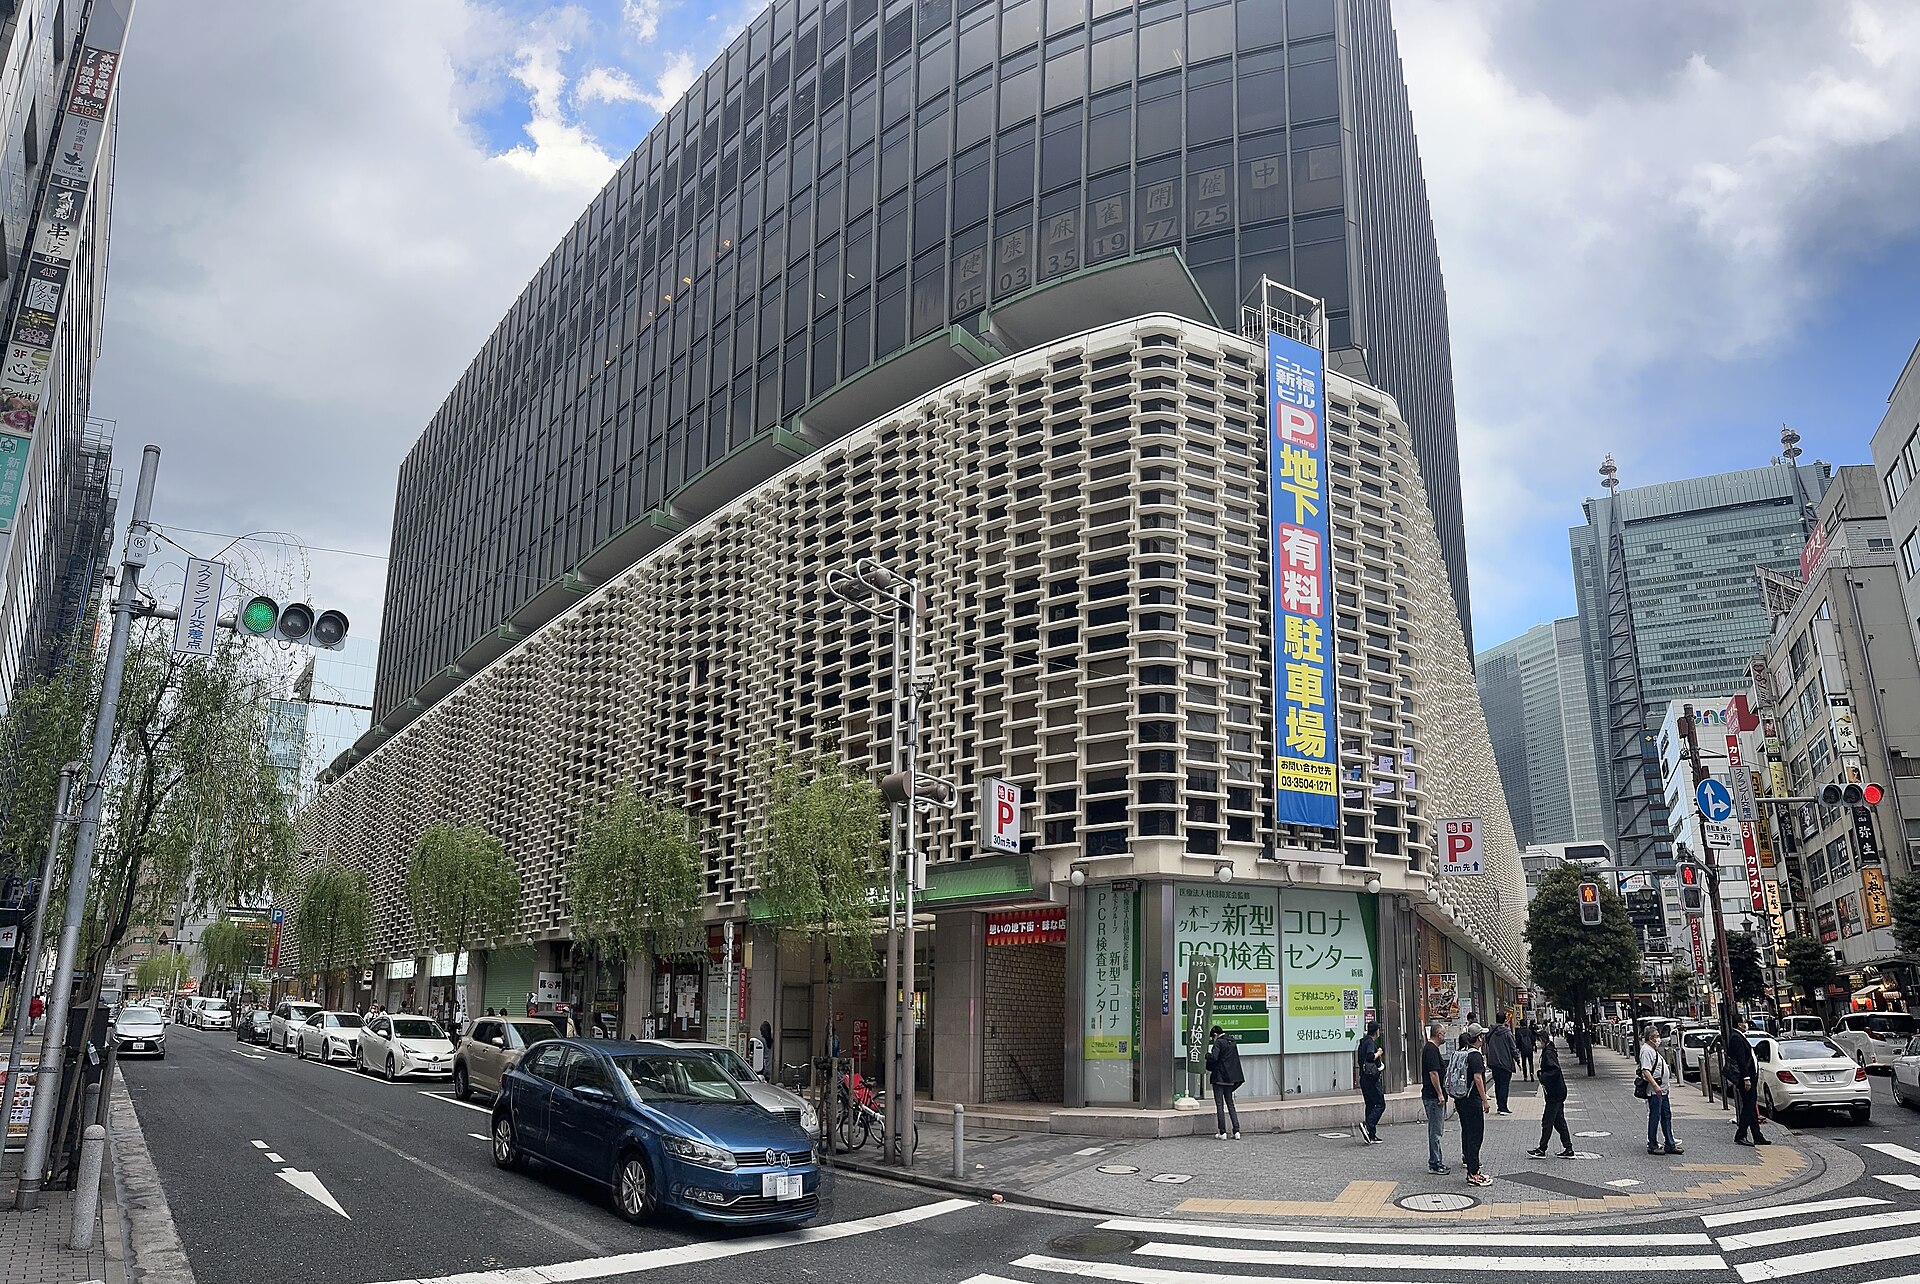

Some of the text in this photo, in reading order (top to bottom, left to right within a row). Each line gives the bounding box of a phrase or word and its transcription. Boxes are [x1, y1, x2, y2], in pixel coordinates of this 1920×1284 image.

[73, 96, 105, 109] 生ビール
[60, 177, 80, 187] 6F
[44, 253, 60, 264] 5F
[956, 204, 1228, 311] 6F 03 35 19 77 25
[13, 349, 28, 359] 3F
[1276, 354, 1316, 376] ニュー
[1276, 368, 1316, 395] 新橋
[1277, 383, 1316, 409] ビル
[186, 564, 213, 650] スクランブル交差点
[1280, 760, 1332, 776] お問い合わせ先
[998, 785, 1014, 802] 地下
[998, 800, 1014, 834] P
[1447, 822, 1472, 833] 地下
[1859, 825, 1876, 855] 弥生
[1447, 835, 1473, 863] P
[1443, 863, 1471, 873] 30m先
[1747, 855, 1762, 899] カラオケ
[274, 910, 283, 920] P
[1188, 905, 1209, 919] 木下
[1221, 902, 1351, 937] 新型コロナ
[1876, 915, 1886, 923] 2F
[1178, 920, 1220, 933] グループ
[1690, 918, 1703, 968] パチンコ スロット
[1095, 892, 1108, 1030] PCR検査センター
[1351, 968, 1364, 978] 新橋
[1109, 951, 1121, 1029] 新型コロナ
[1293, 991, 1336, 1001] ご予約はこちら
[1189, 972, 1207, 1063] PCR検査
[1296, 1028, 1342, 1041] 受付はこちら
